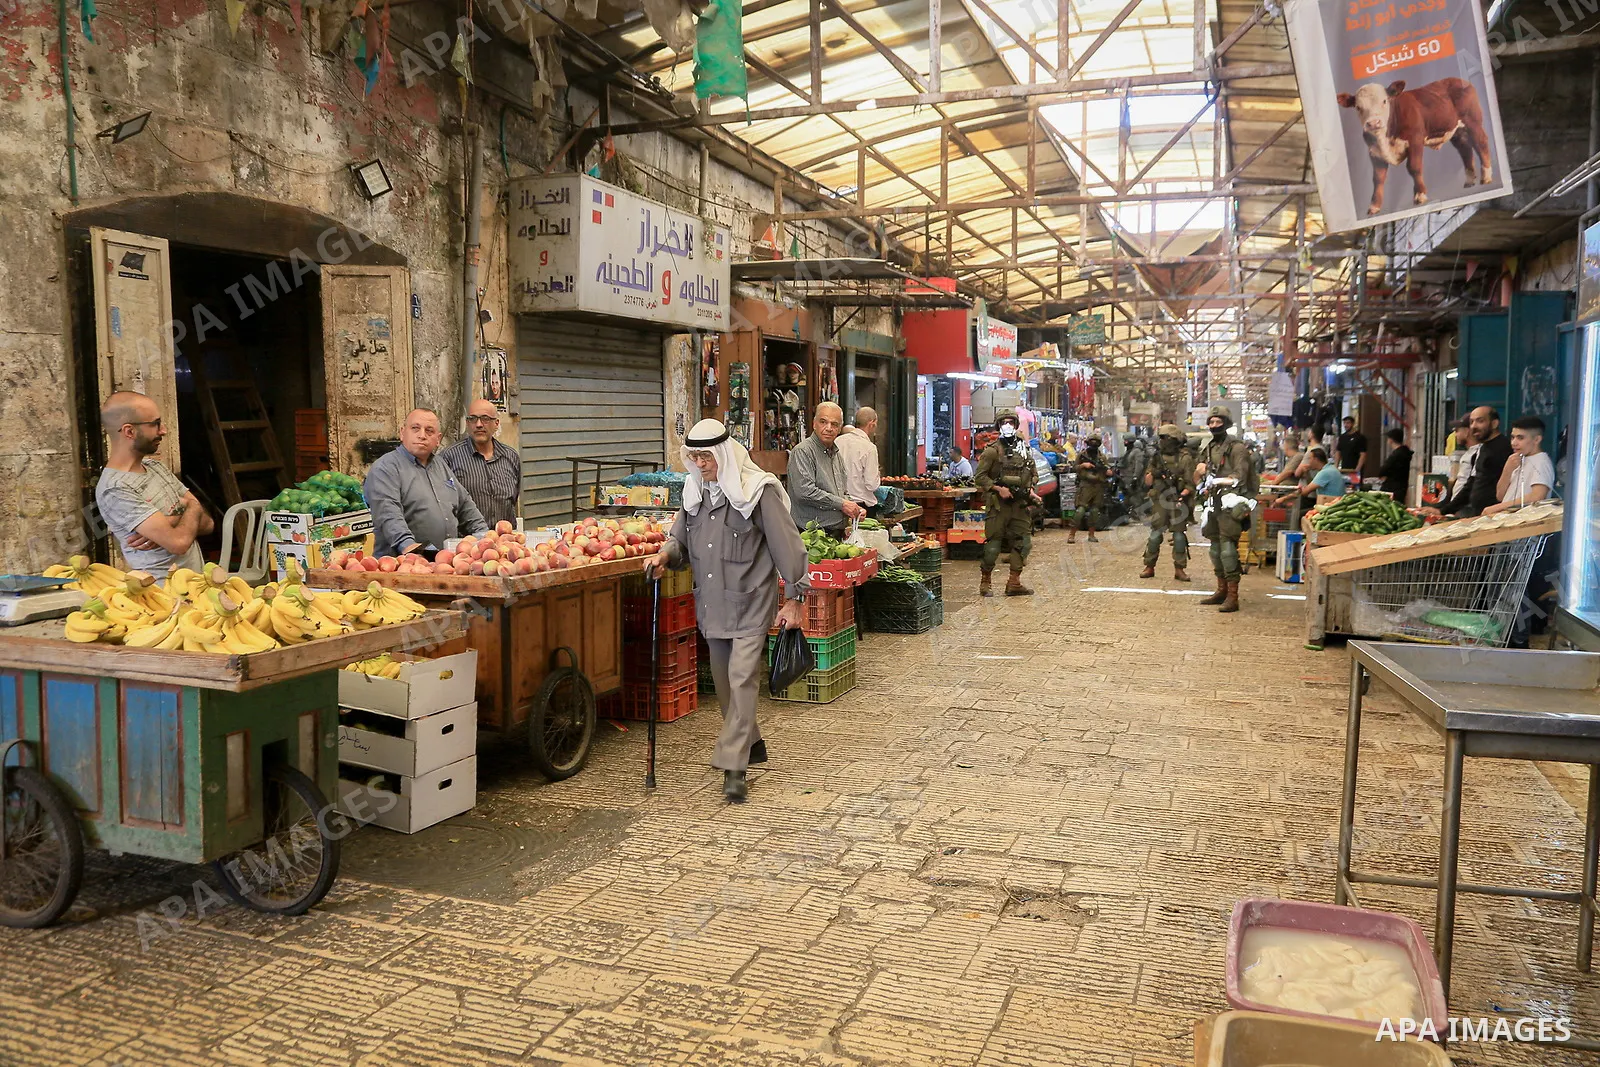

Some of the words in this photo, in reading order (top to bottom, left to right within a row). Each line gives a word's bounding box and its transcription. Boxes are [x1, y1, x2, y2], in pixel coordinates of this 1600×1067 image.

[1366, 44, 1414, 74] شيكل
[1418, 39, 1441, 57] 60
[519, 187, 570, 210] الخراز
[637, 208, 693, 259] الخراز
[540, 250, 548, 266] و
[662, 270, 671, 305] و
[342, 362, 370, 380] الرسول
